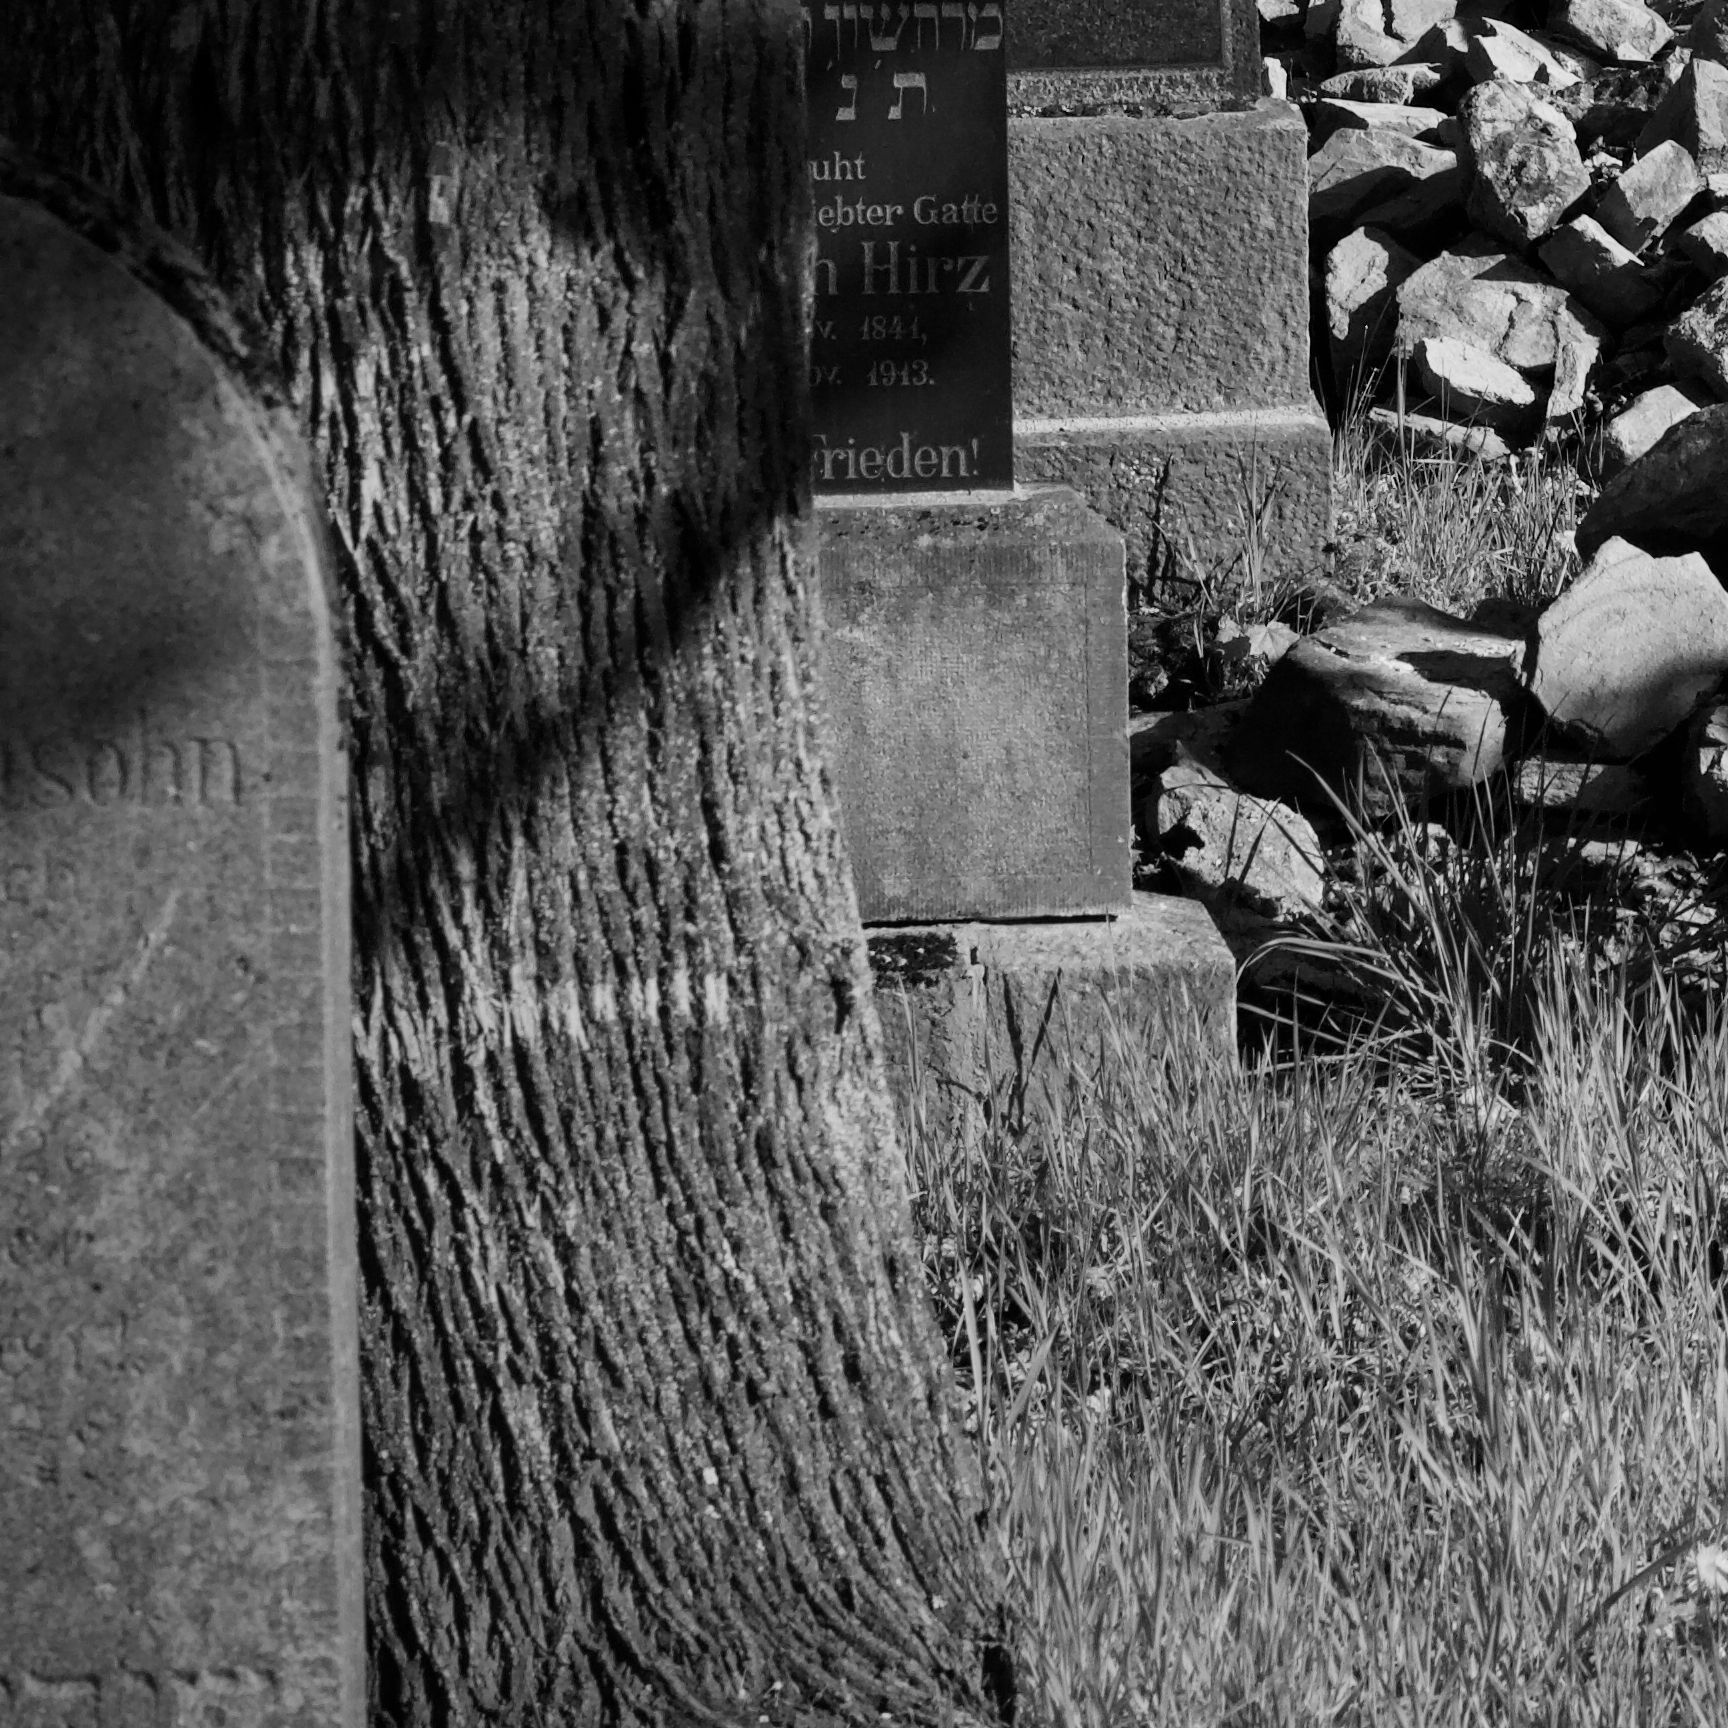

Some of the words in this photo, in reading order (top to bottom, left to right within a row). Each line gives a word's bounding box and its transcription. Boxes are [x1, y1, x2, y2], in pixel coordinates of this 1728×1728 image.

[810, 150, 867, 181] uht
[912, 193, 1000, 227] Gatte
[860, 239, 991, 295] Hirz
